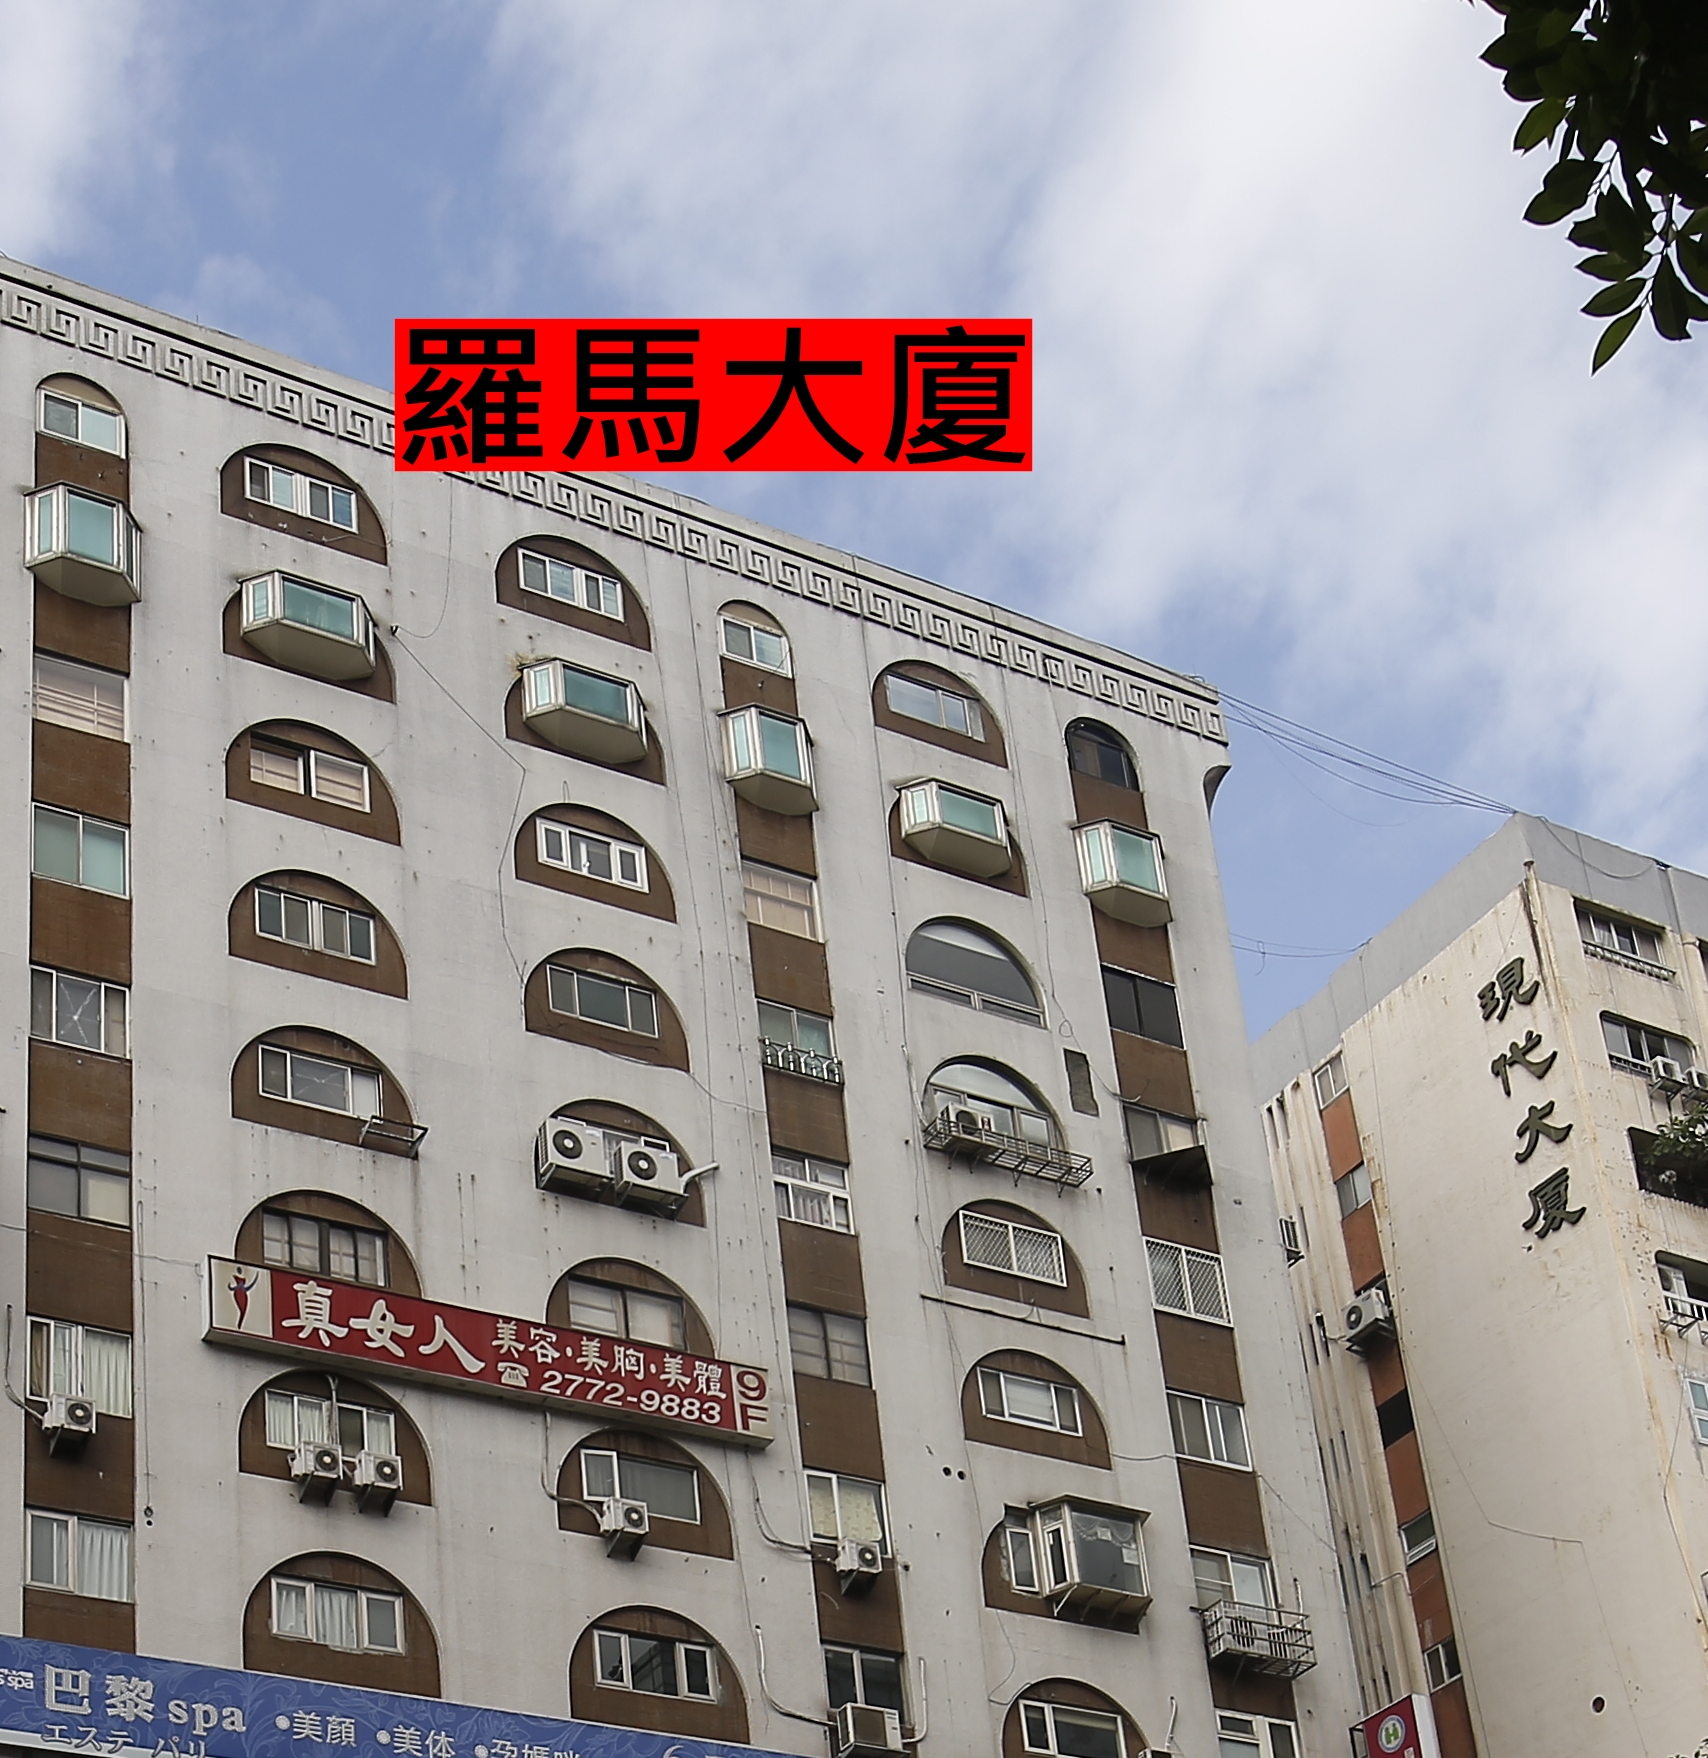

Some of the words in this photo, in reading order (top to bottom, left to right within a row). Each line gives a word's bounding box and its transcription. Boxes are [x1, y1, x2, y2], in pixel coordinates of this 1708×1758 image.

[1477, 956, 1586, 1239] 現代大廈
[282, 1280, 486, 1374] 真女人
[542, 1371, 723, 1424] 2772-9883
[41, 1722, 134, 1756] エステ
